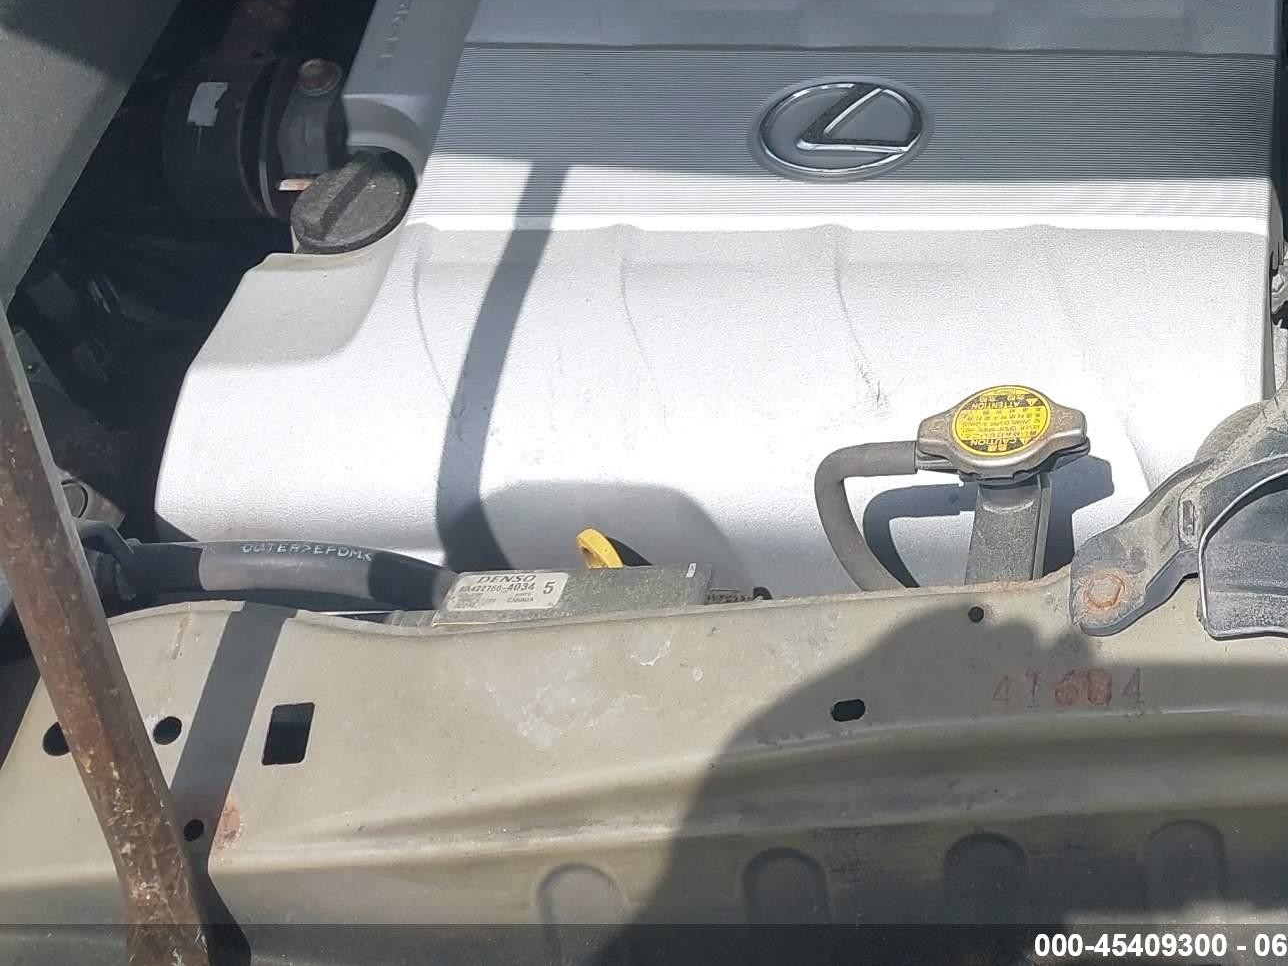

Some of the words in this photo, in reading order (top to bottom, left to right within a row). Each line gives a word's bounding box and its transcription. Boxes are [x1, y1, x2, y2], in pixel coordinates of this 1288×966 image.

[971, 401, 1020, 410] ATTENTION
[970, 438, 1017, 446] CAUTION
[477, 575, 537, 583] DENSO
[543, 580, 556, 595] 5
